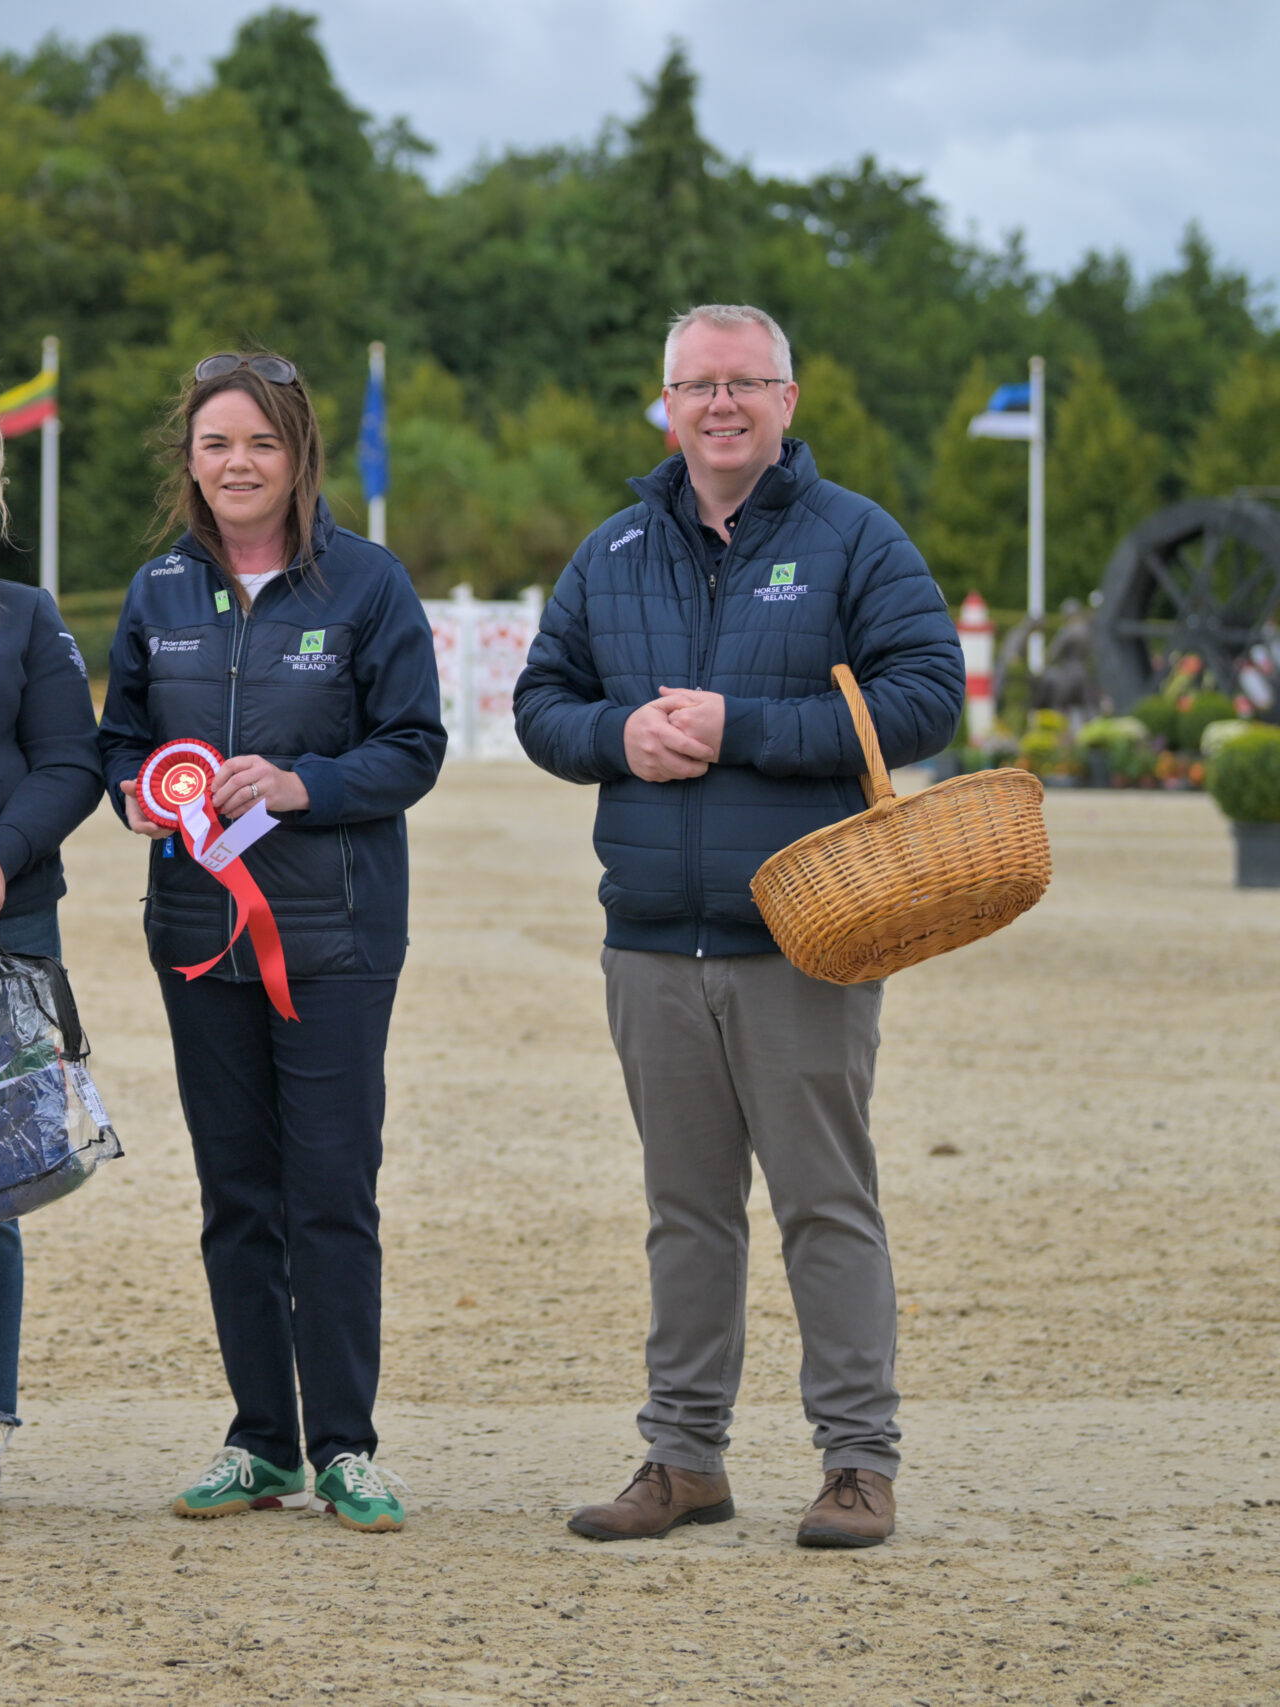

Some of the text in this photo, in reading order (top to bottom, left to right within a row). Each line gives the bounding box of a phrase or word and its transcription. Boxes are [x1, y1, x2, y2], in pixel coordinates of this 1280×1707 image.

[754, 585, 808, 595] HORSE SPORT
[762, 594, 797, 602] IRELAND
[282, 654, 337, 662] HORSE SPORT
[292, 663, 326, 671] IRELAND
